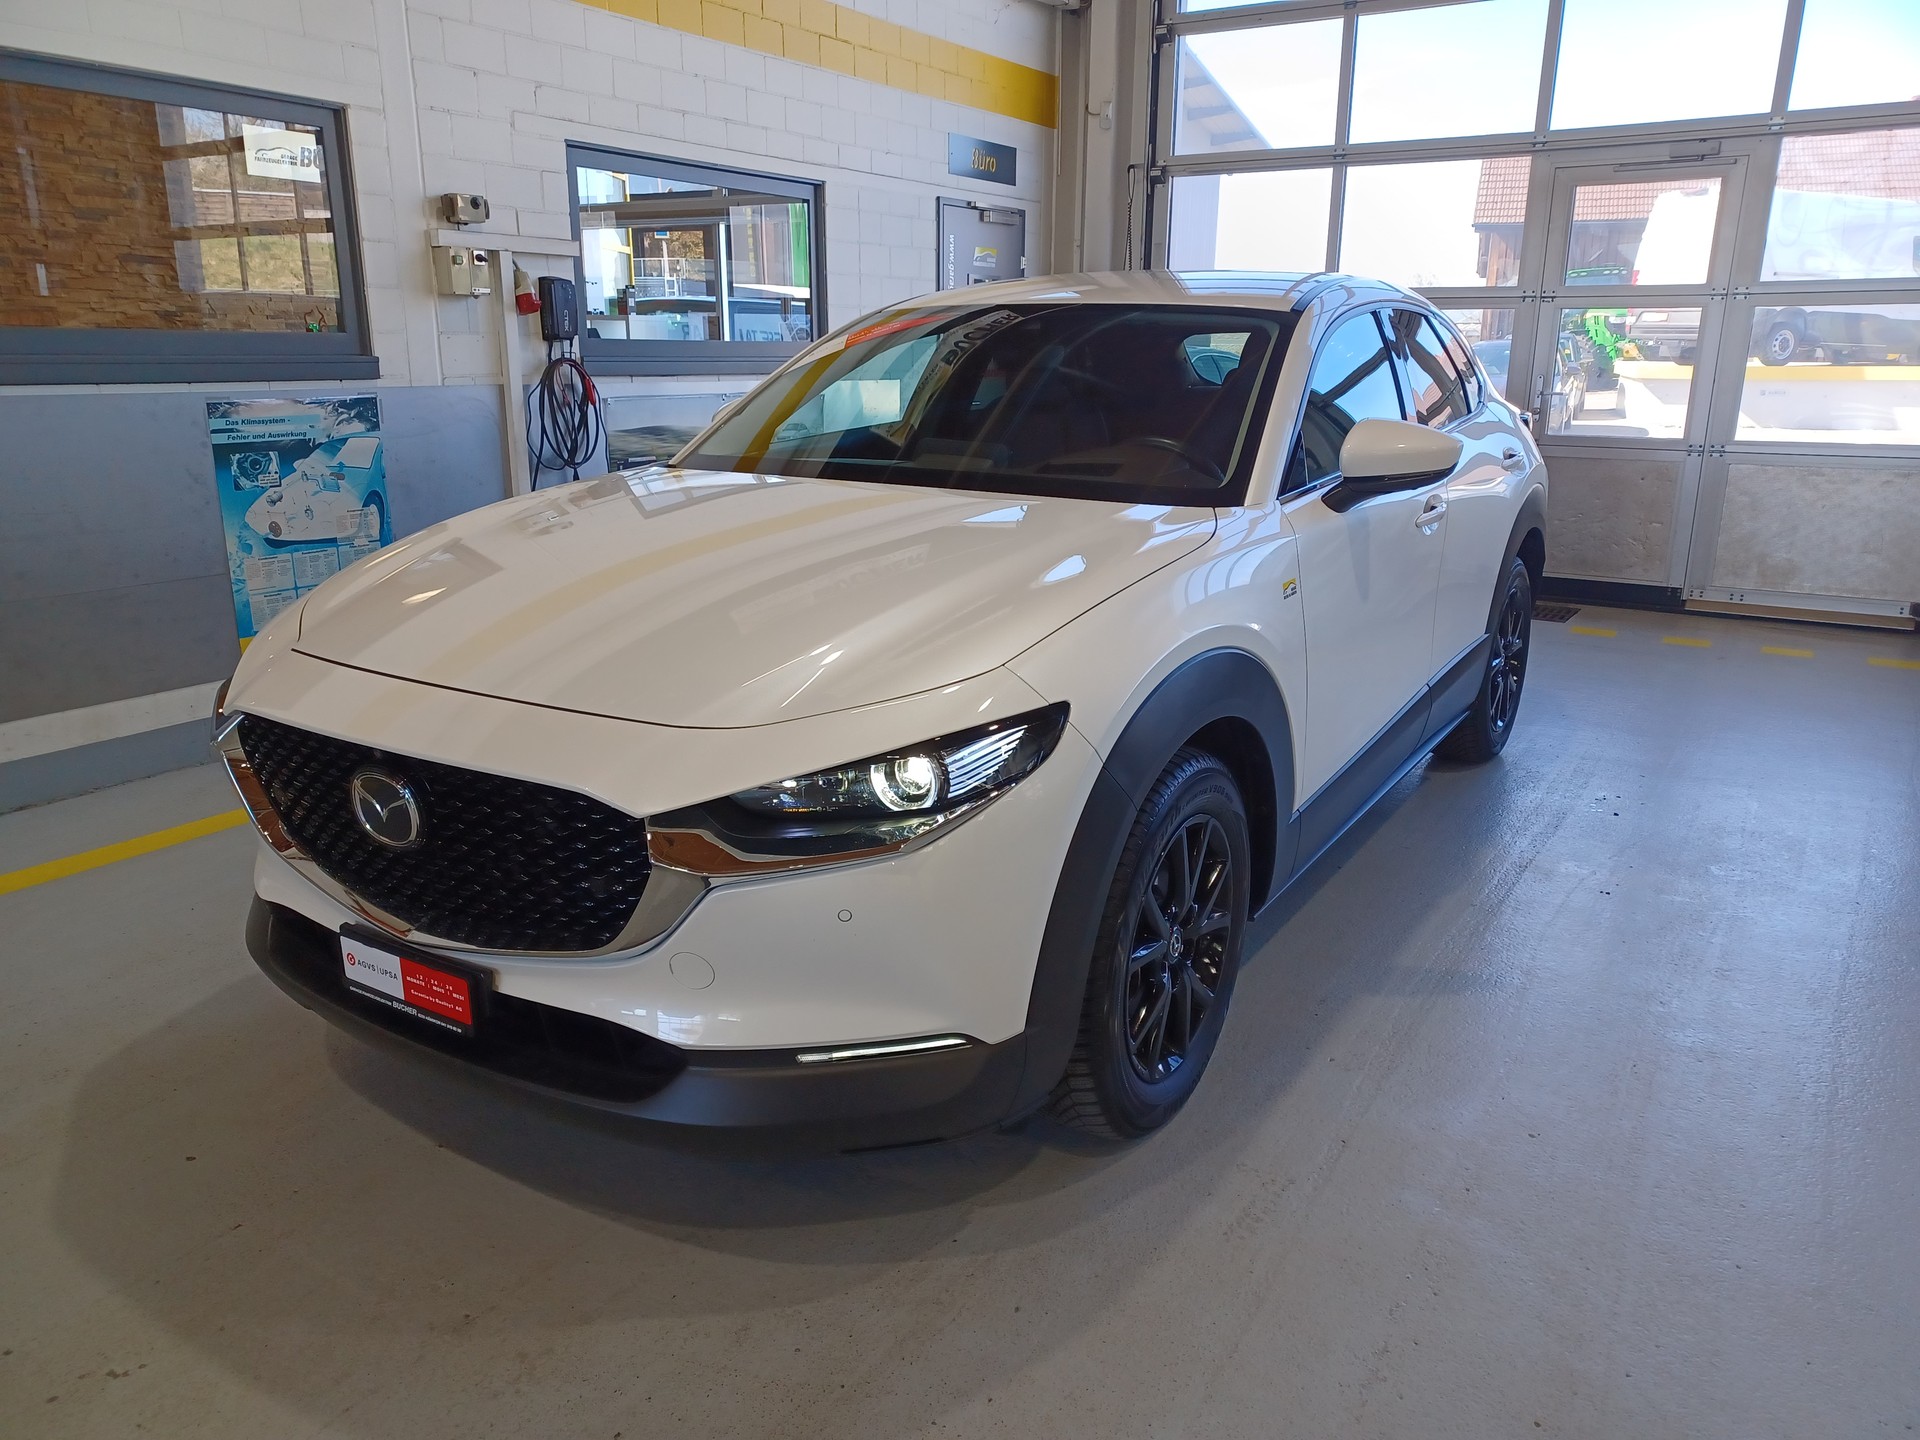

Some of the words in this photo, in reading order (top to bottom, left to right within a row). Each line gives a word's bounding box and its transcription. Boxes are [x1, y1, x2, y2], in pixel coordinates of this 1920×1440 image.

[971, 147, 996, 173] Büro
[225, 418, 239, 426] Das
[241, 417, 286, 427] Klimasystem
[227, 433, 250, 441] Fehler
[252, 432, 266, 440] und
[268, 431, 307, 440] Auswirkung
[392, 1000, 418, 1017] BUCHER
